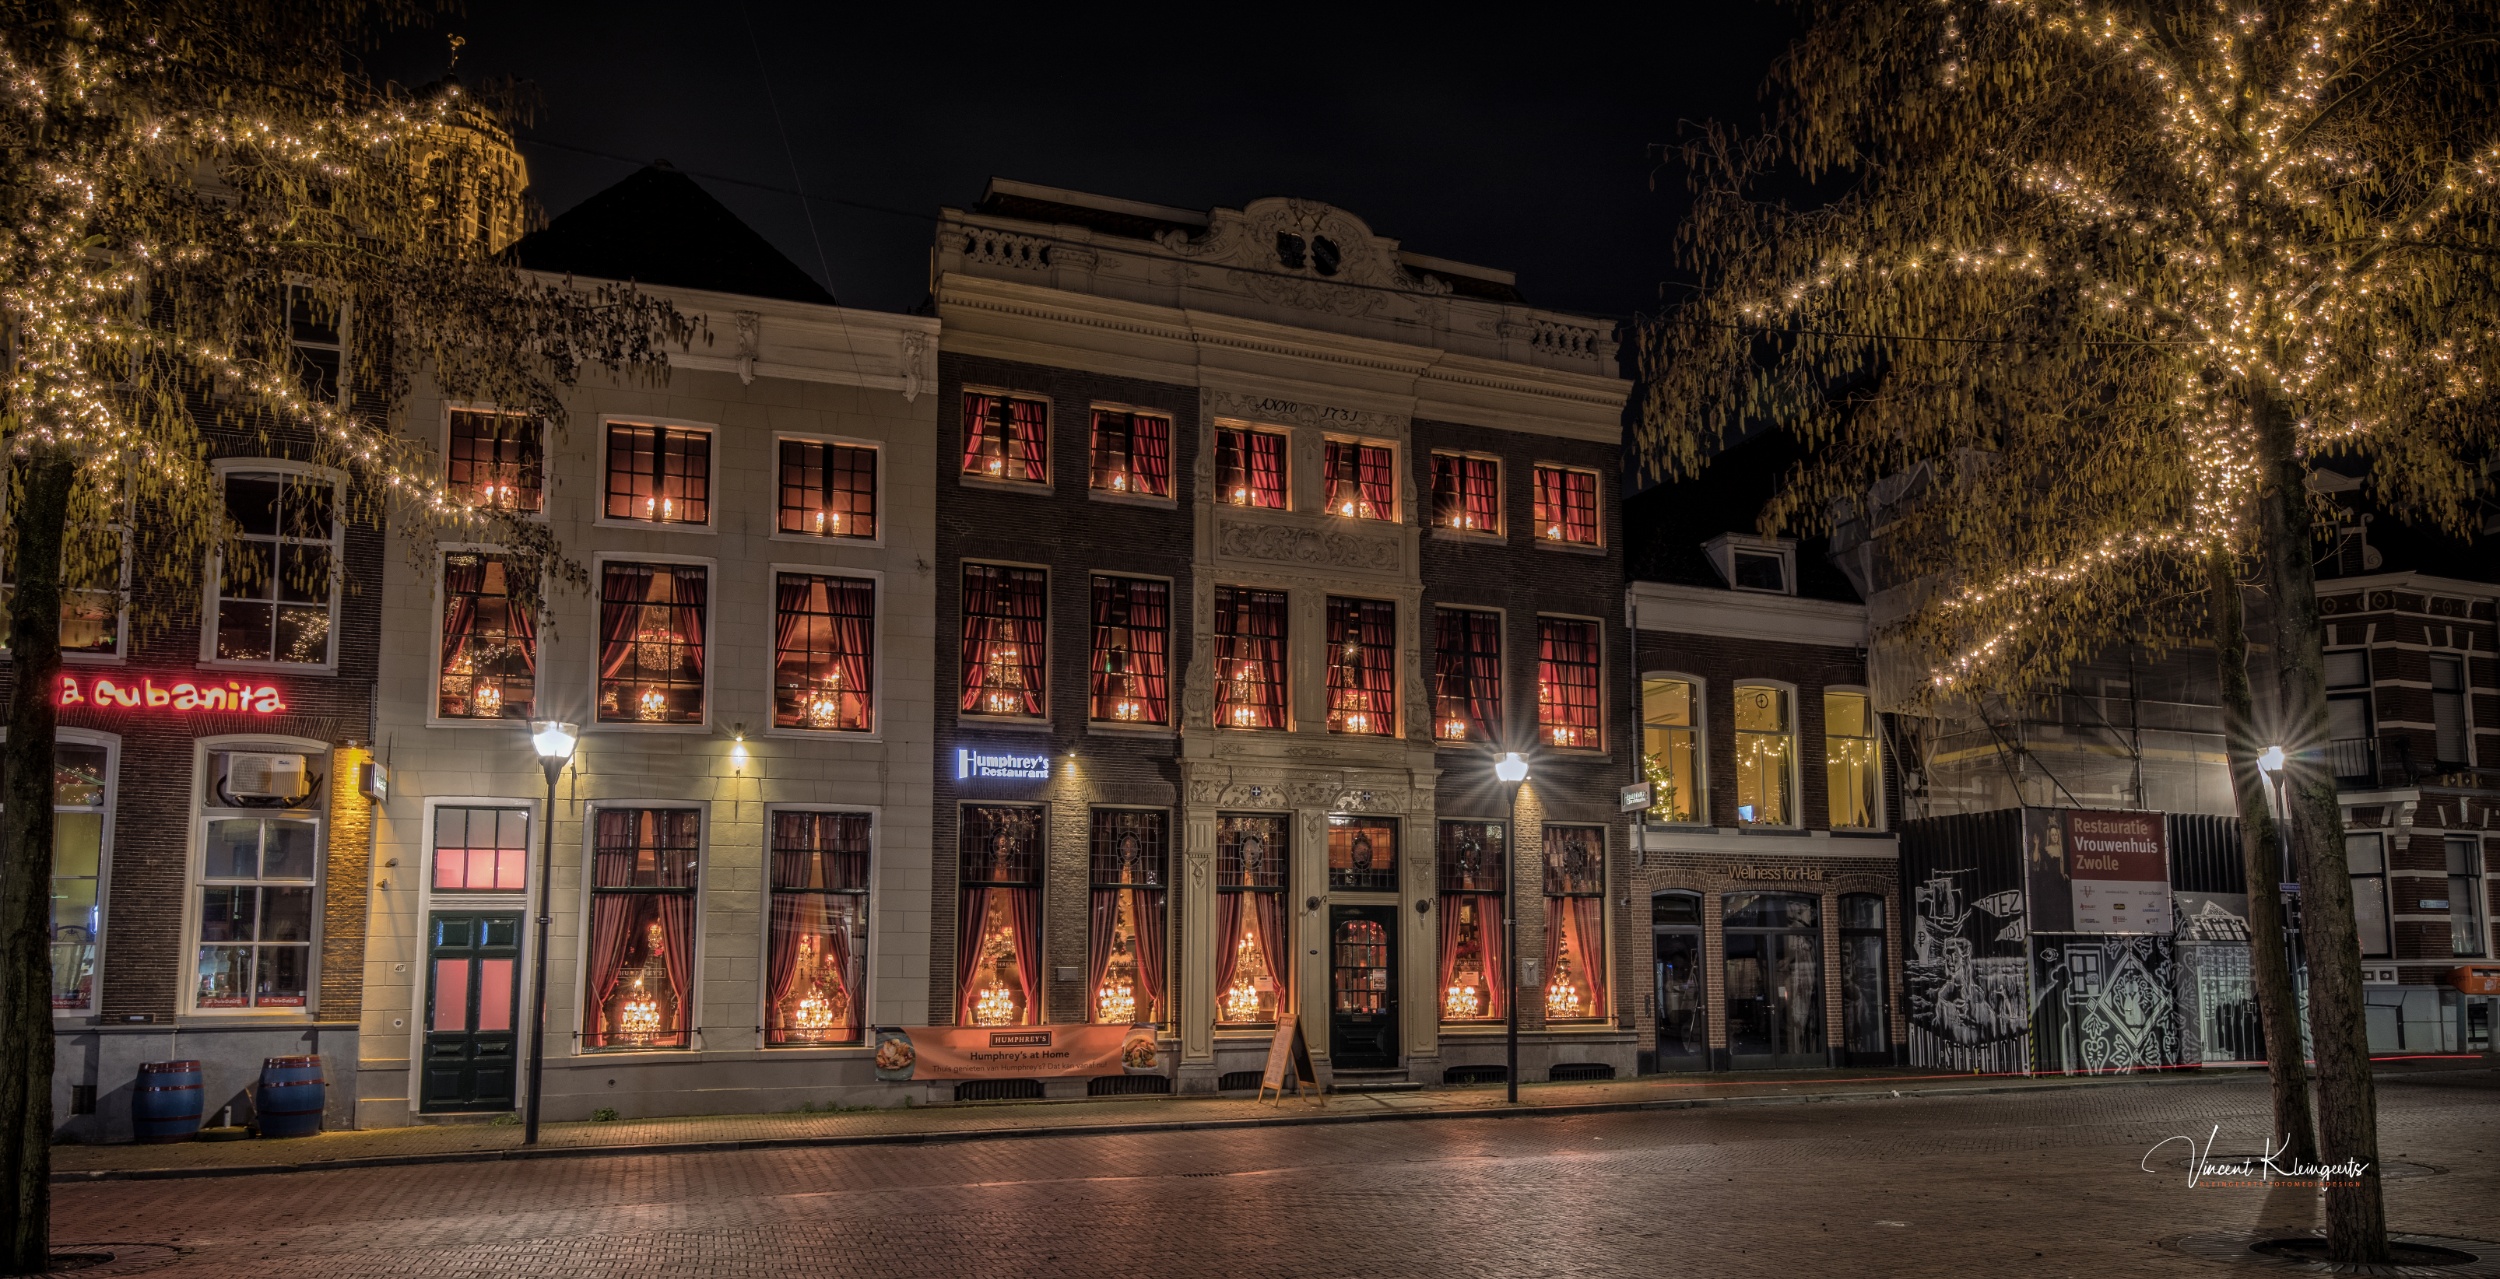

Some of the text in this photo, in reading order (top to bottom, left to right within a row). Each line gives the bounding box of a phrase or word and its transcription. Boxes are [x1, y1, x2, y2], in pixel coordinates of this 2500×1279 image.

[1255, 398, 1358, 422] ANNO 1731
[61, 677, 84, 705] a
[958, 749, 1050, 778] Humphrey's
[981, 767, 1049, 778] Restaurant
[2074, 818, 2148, 835] Restauratie
[2074, 836, 2158, 854] Vrouwenhuis
[2076, 855, 2119, 871] Zwolle
[1728, 865, 1823, 881] Wellness for Hair
[995, 1035, 1047, 1044] HUMPHREY'S
[970, 1050, 1070, 1062] Humphrey's at Home
[932, 1065, 952, 1073] Thuis
[953, 1064, 985, 1074] genieten
[1047, 1062, 1060, 1070] Dat
[1061, 1061, 1075, 1069] kan
